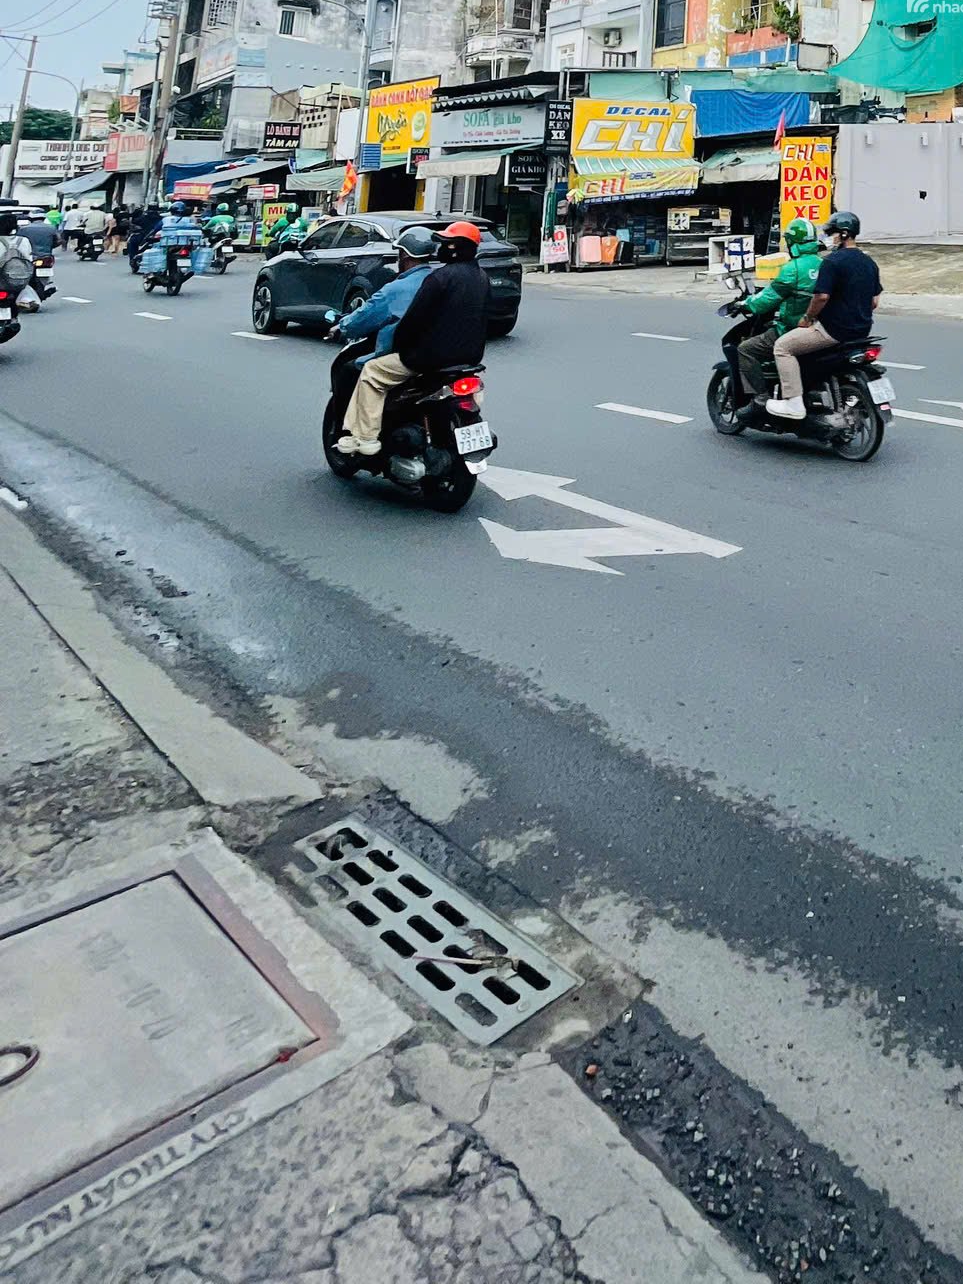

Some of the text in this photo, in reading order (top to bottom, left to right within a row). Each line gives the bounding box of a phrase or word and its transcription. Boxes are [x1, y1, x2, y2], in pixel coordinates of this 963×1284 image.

[463, 110, 490, 127] SOFA
[549, 109, 571, 120] DÁN
[606, 106, 671, 116] DECAL
[549, 120, 570, 130] KEO
[576, 109, 692, 152] CHÍ
[551, 130, 566, 140] XE
[783, 137, 816, 161] CHÍ
[784, 162, 829, 182] DÁN
[784, 184, 828, 201] KEO
[794, 205, 820, 220] XE
